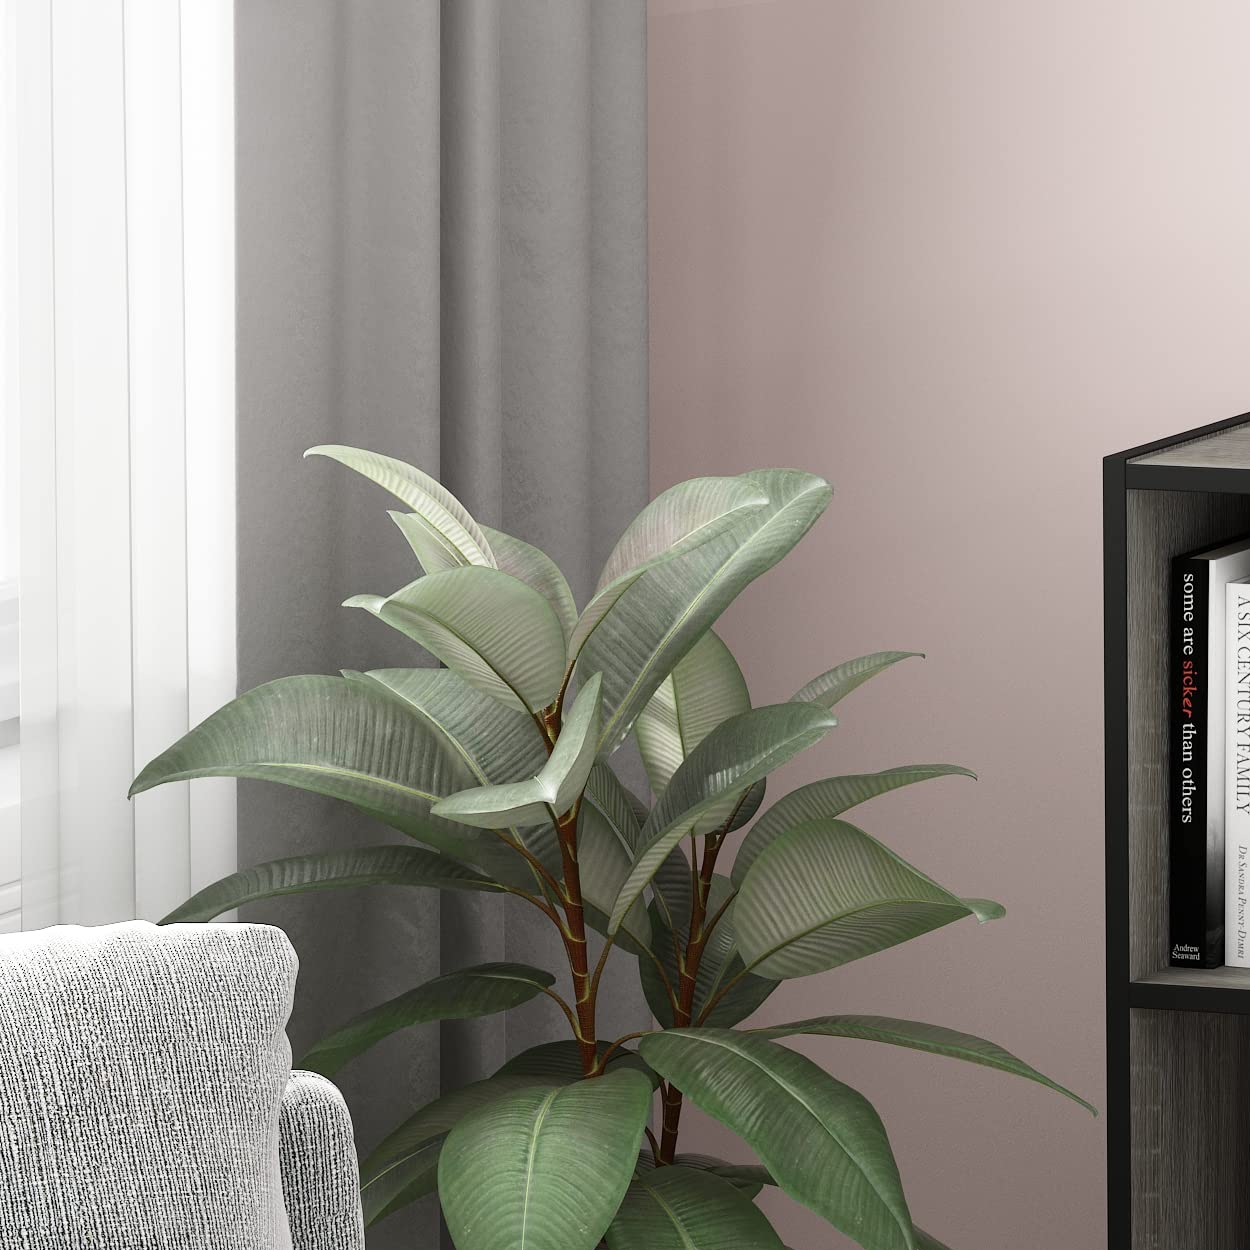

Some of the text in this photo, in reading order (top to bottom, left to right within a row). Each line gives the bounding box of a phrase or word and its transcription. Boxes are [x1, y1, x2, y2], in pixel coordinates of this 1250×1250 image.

[1181, 573, 1198, 823] some are sicker than others
[1236, 743, 1250, 815] FAMILY
[1171, 950, 1200, 961] Seaward
[1173, 943, 1200, 953] Andrew
